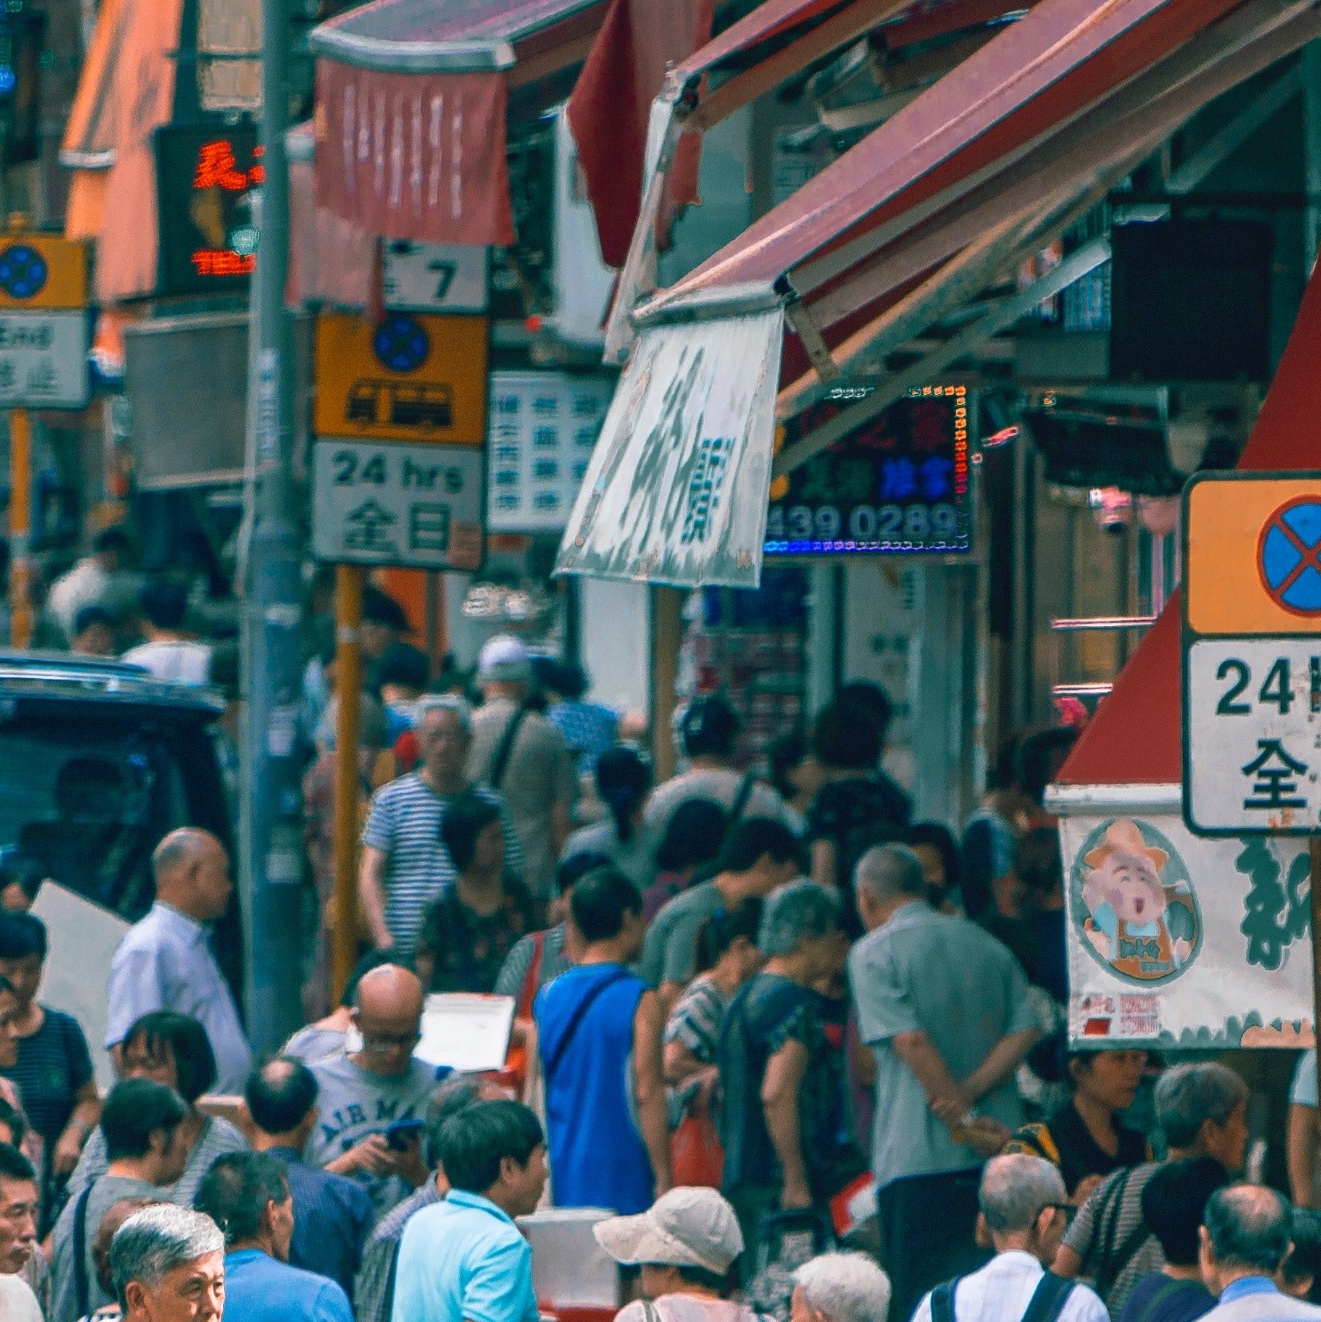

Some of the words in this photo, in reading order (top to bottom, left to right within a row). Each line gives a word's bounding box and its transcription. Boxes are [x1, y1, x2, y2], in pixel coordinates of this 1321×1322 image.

[427, 260, 457, 299] 7
[332, 450, 388, 488] 24
[400, 455, 466, 495] hrs
[342, 499, 452, 551] 全日
[849, 503, 958, 541] 0289
[320, 1103, 368, 1144] AIR
